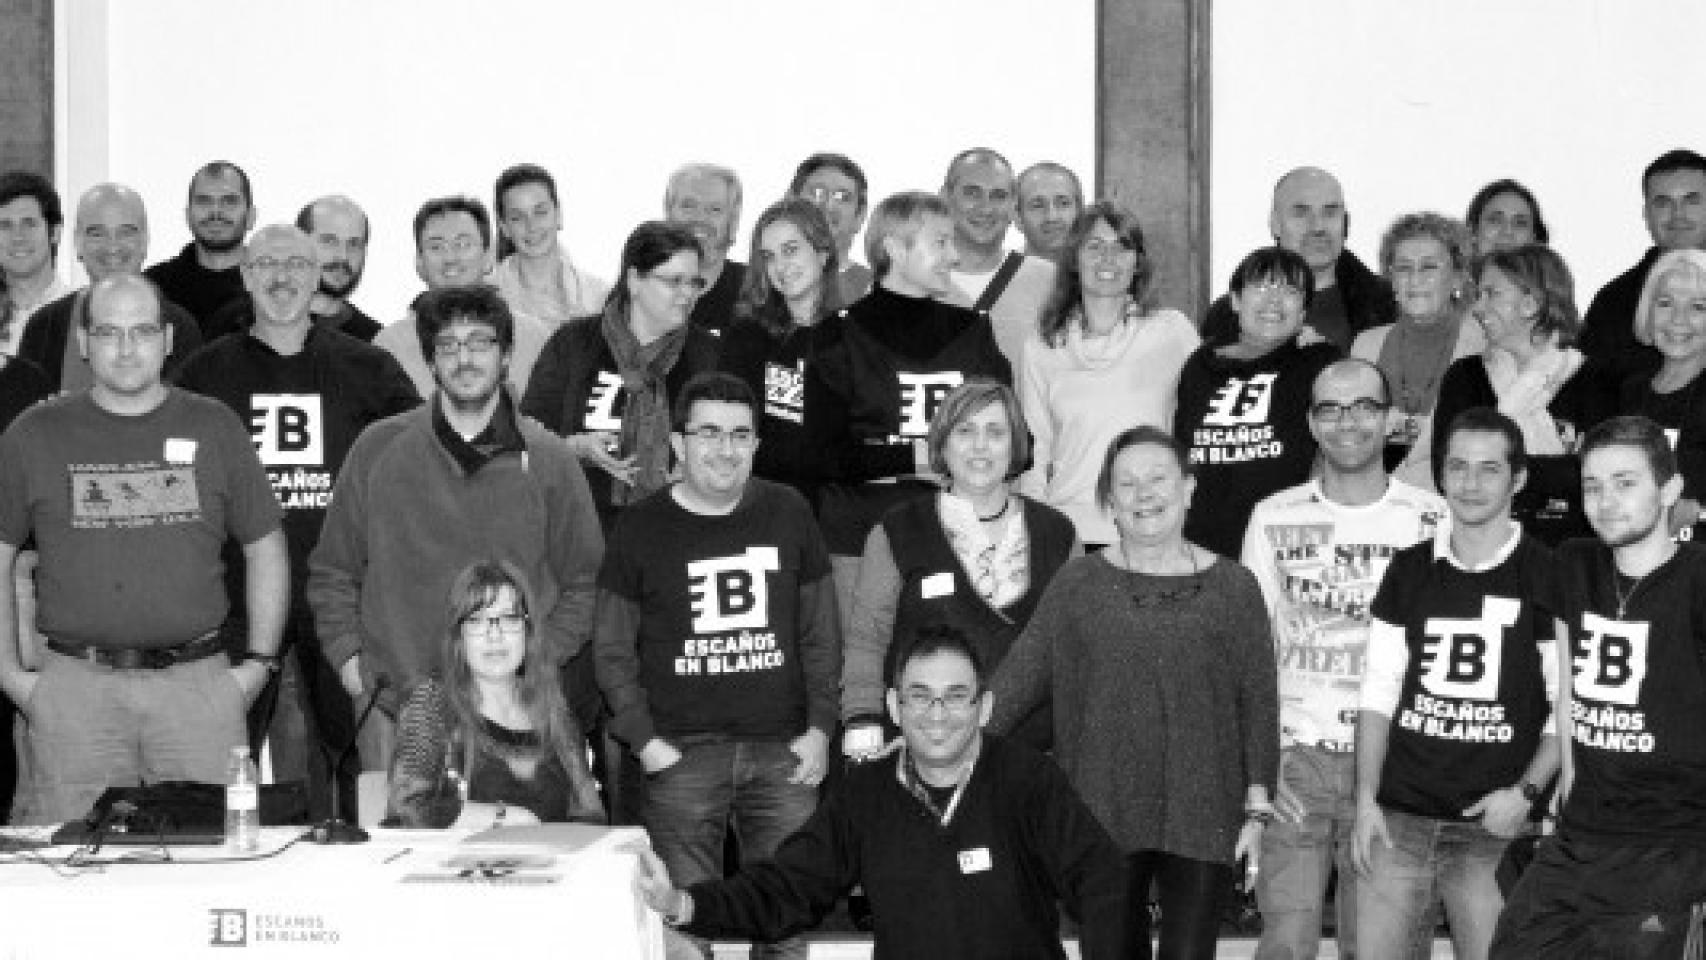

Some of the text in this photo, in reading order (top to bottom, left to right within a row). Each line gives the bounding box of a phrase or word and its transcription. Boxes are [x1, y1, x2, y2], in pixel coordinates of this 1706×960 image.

[684, 630, 776, 657] ESCAÑOS
[674, 649, 785, 676] EN BLANCO
[1414, 693, 1505, 722] ESCAÑOS
[1424, 716, 1514, 743] BLANCO
